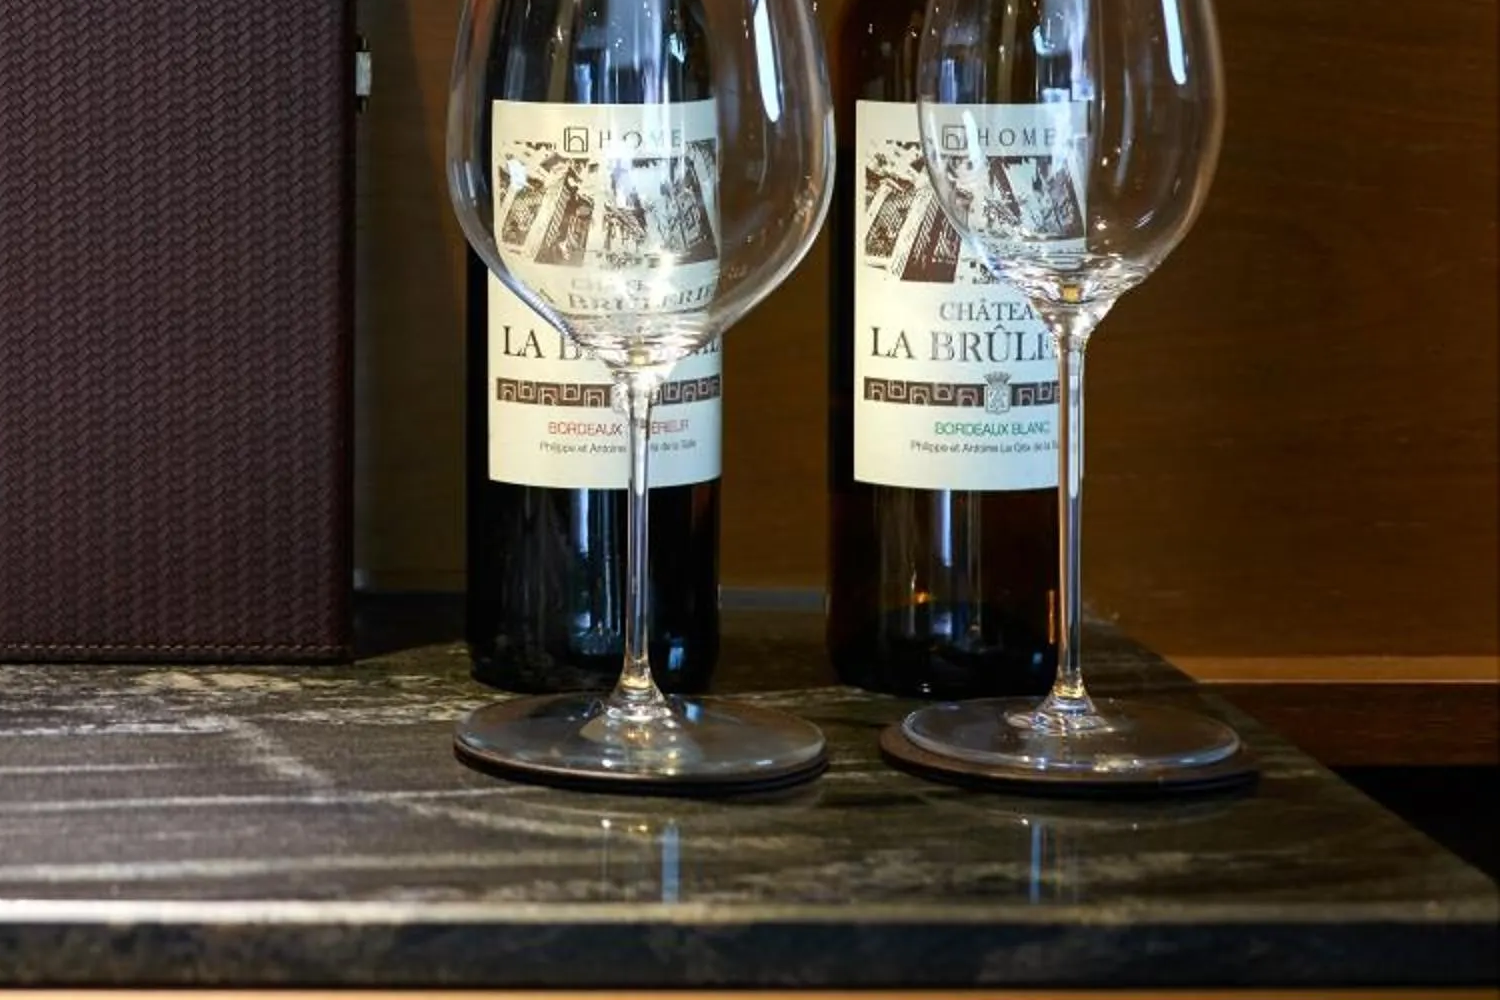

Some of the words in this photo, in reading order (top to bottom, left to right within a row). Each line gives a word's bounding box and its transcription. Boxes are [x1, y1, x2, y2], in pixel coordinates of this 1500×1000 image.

[977, 127, 1055, 147] HOME
[940, 298, 1034, 321] CHÂTEA
[502, 326, 545, 359] LA
[871, 326, 916, 359] LA
[930, 325, 1057, 362] BRÛLE
[548, 421, 623, 436] BORDEAUX
[934, 422, 1009, 436] BORDEAUX
[1012, 421, 1050, 435] BLANC
